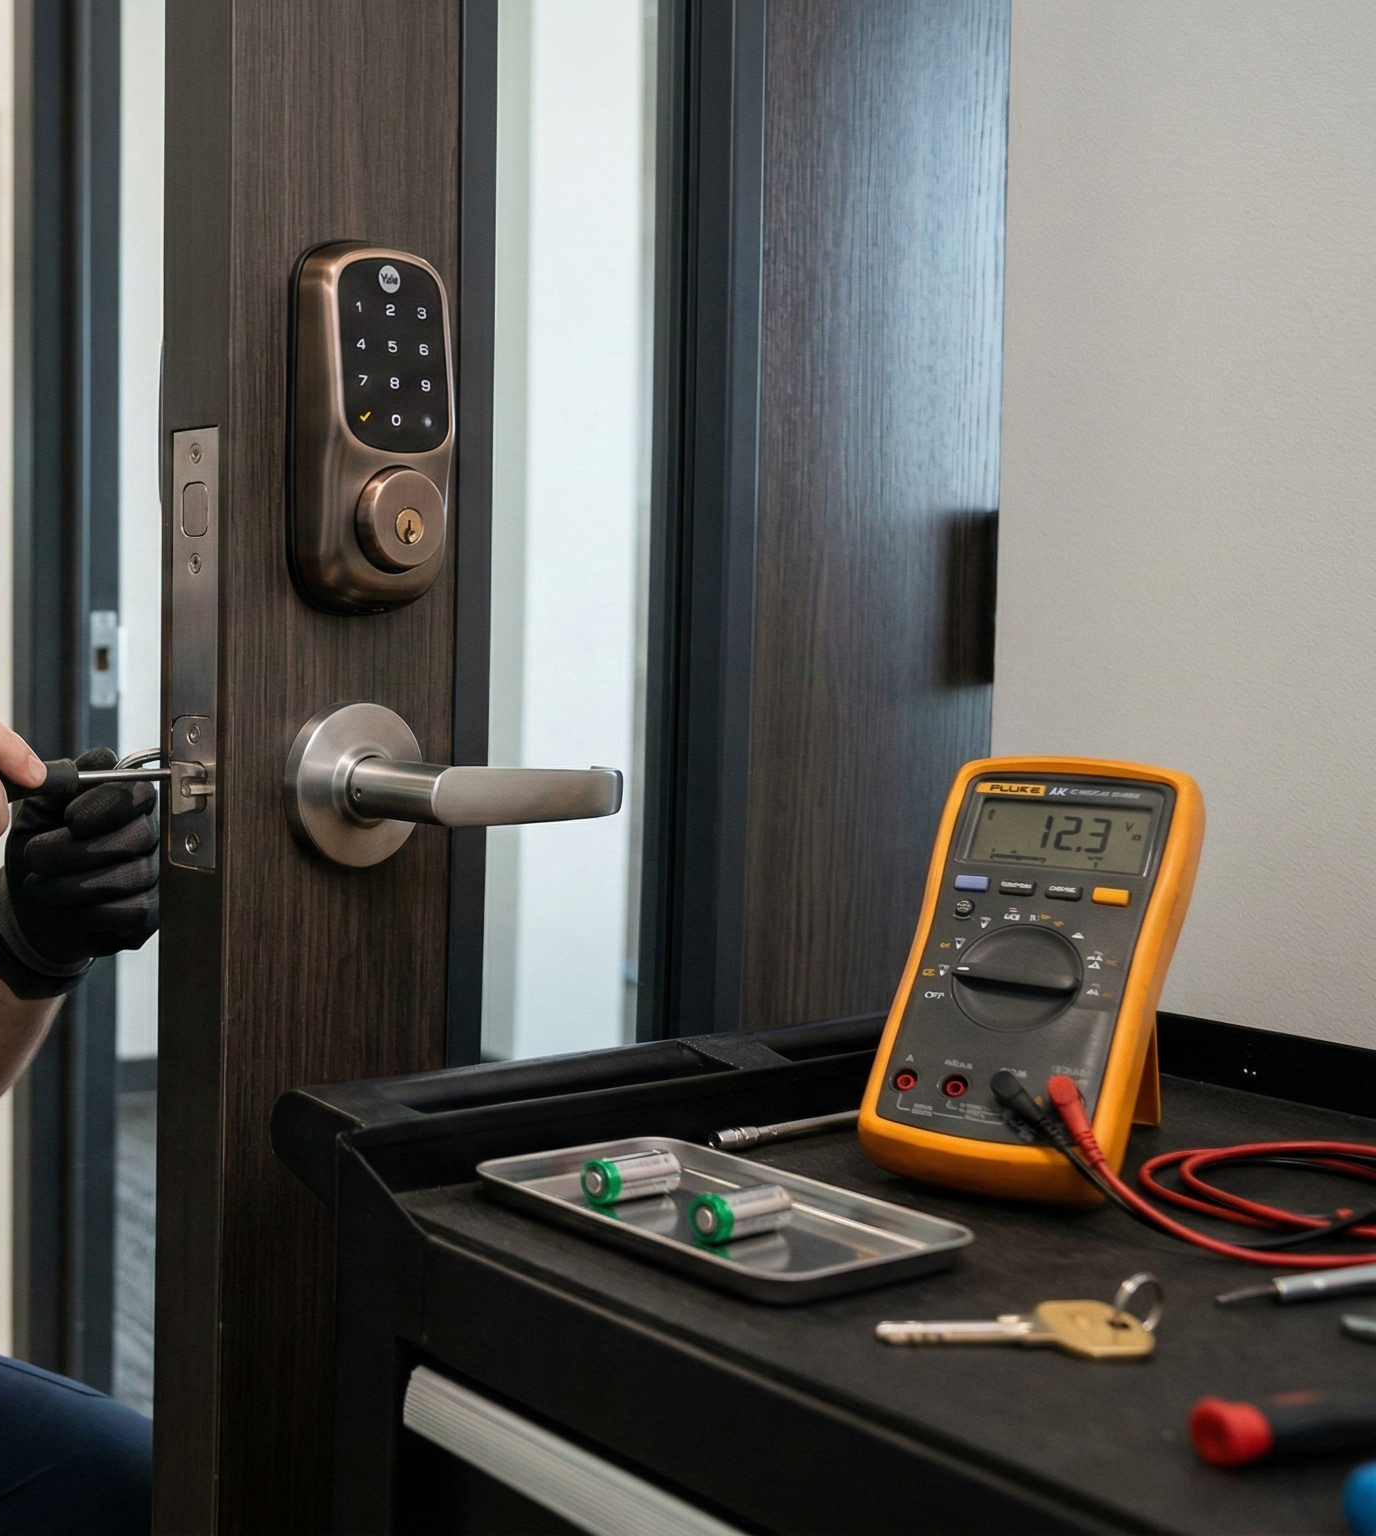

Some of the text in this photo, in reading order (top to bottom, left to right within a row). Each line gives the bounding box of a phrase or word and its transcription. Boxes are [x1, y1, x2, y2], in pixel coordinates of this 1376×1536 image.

[355, 301, 427, 320] 1 2 3
[356, 338, 429, 356] 4 5 6
[358, 374, 431, 392] 7 8 9
[391, 414, 402, 427] 0
[1040, 815, 1112, 853] 12.3
